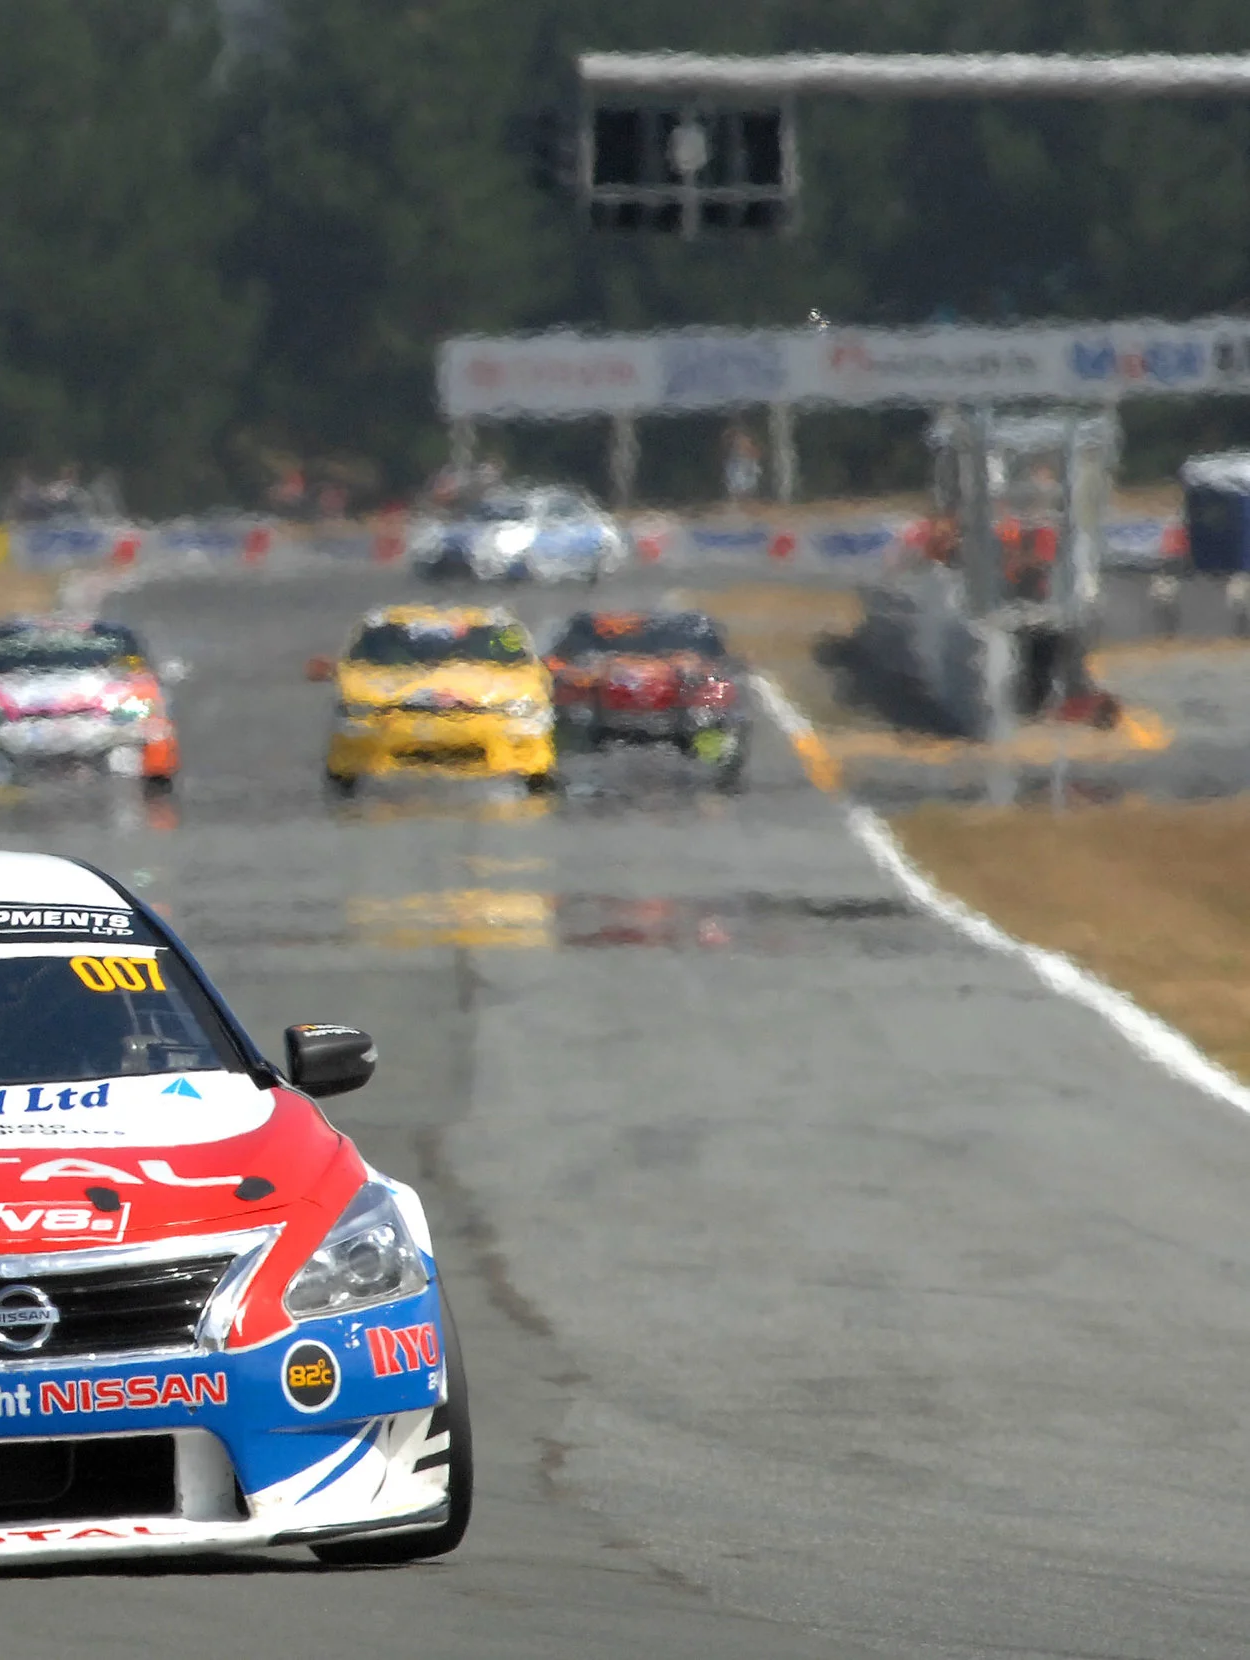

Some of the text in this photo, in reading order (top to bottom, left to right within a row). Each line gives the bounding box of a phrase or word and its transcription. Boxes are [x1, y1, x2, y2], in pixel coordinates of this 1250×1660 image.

[91, 926, 135, 936] LTD
[68, 955, 167, 992] 007
[23, 1083, 111, 1113] Ltd
[39, 1371, 228, 1415] NISSAN
